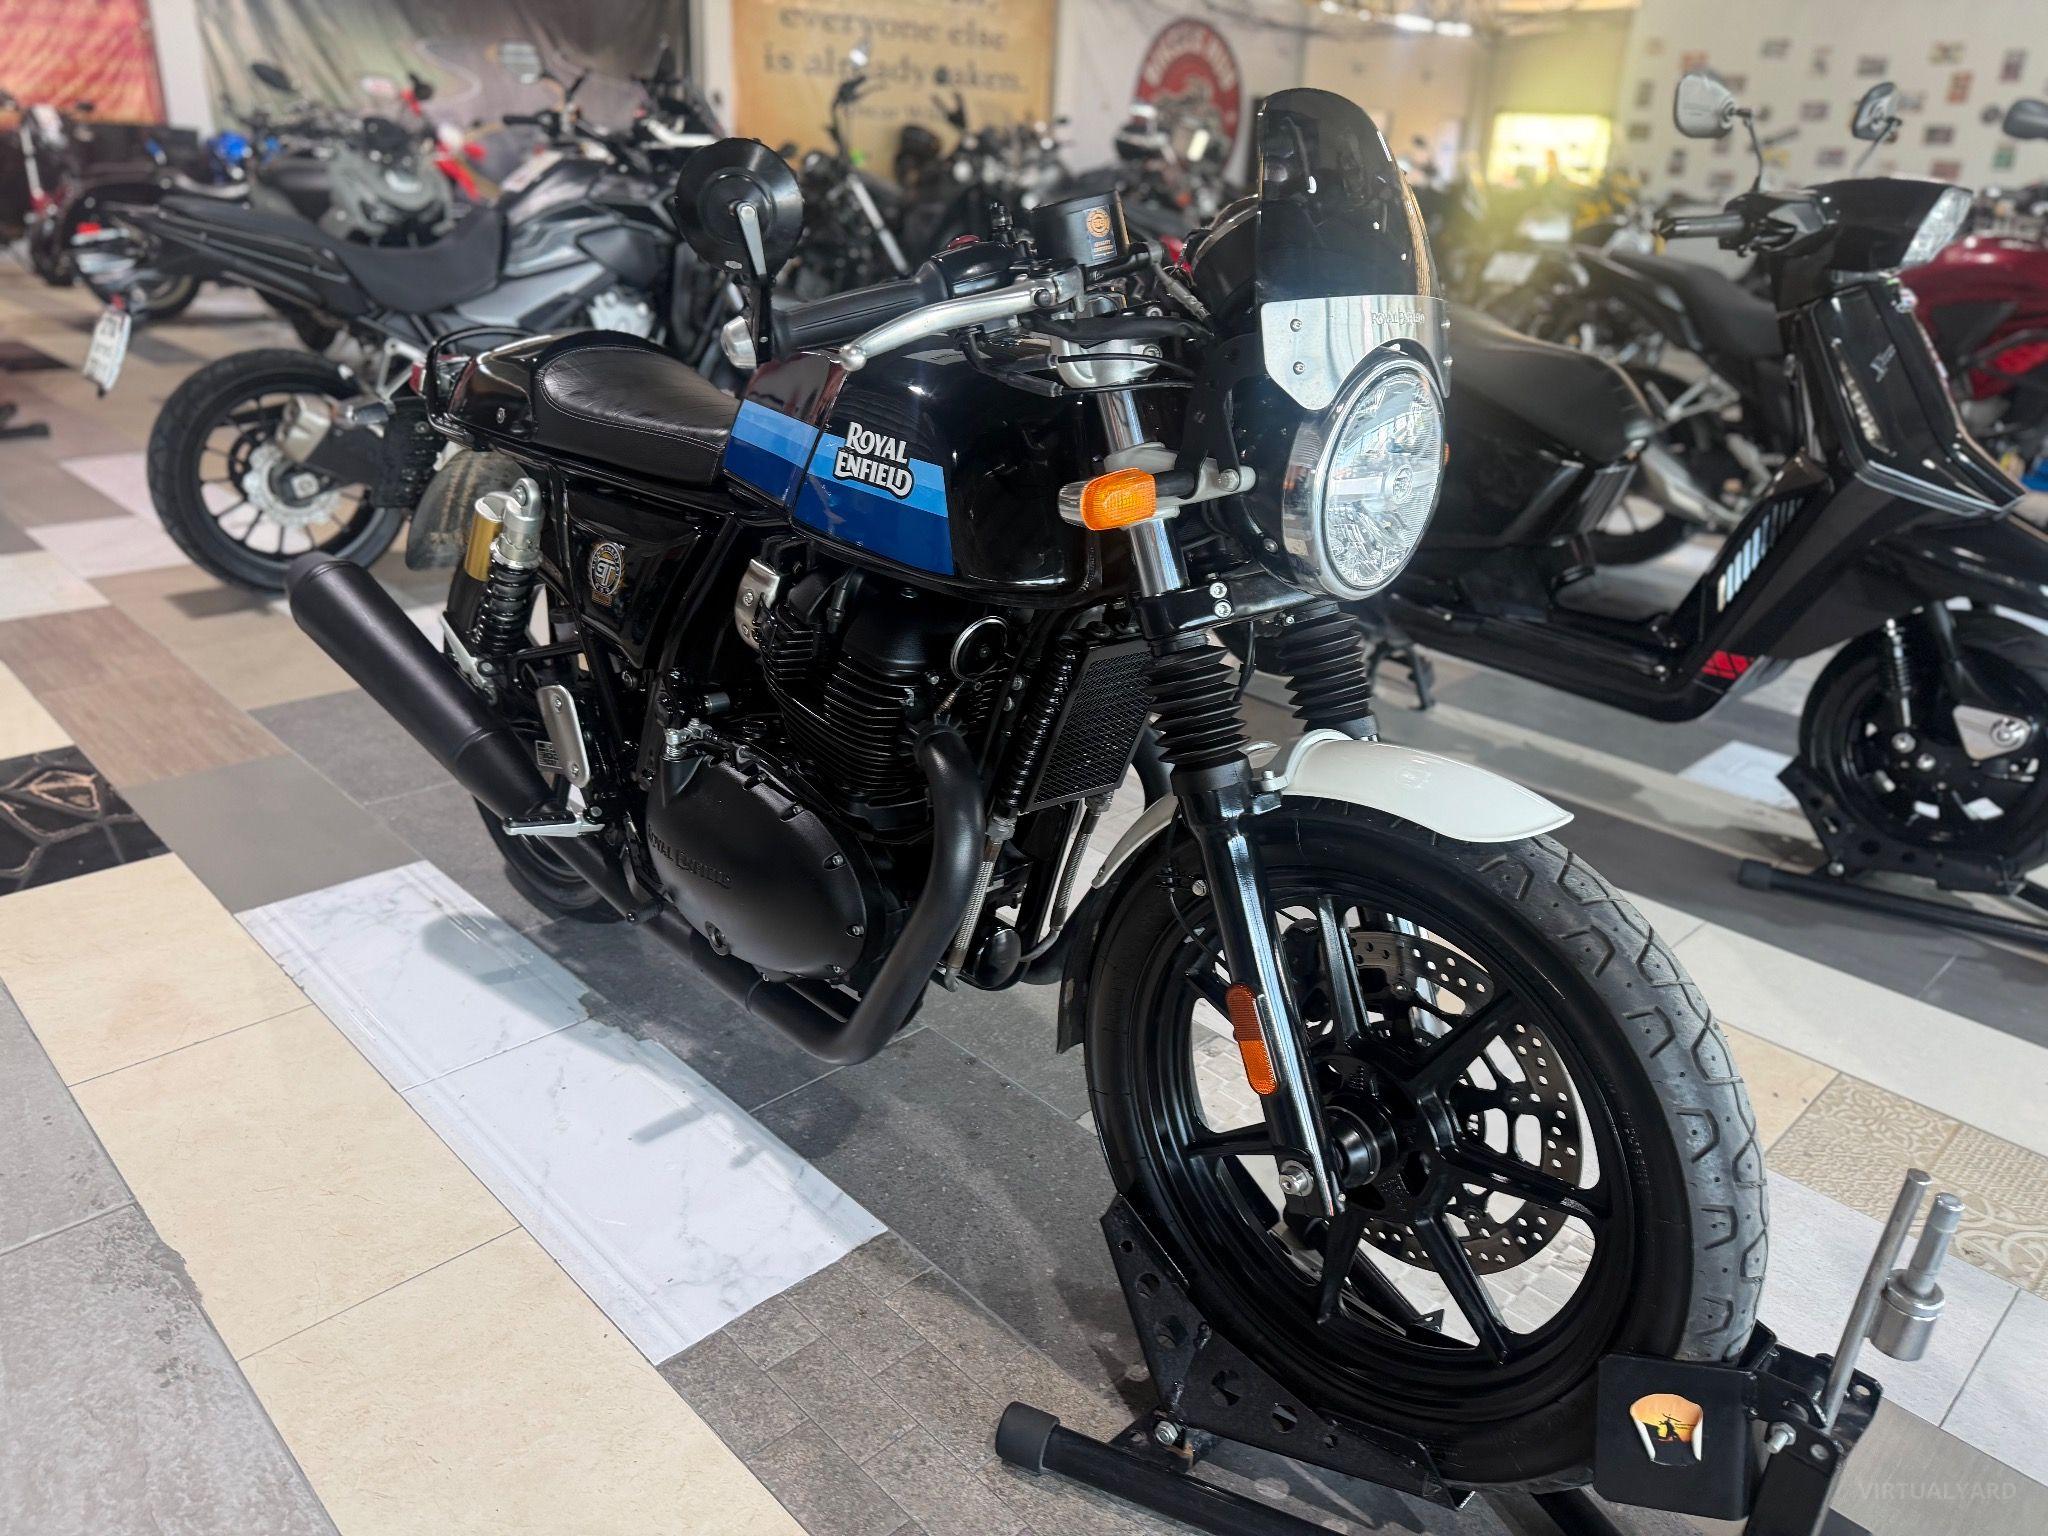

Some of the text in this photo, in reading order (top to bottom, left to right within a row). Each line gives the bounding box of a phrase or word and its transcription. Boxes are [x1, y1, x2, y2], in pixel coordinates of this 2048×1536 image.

[779, 8, 1008, 52] everyone else
[763, 40, 794, 72] is
[845, 421, 908, 465] ROYAL
[834, 450, 913, 497] ENFIELD
